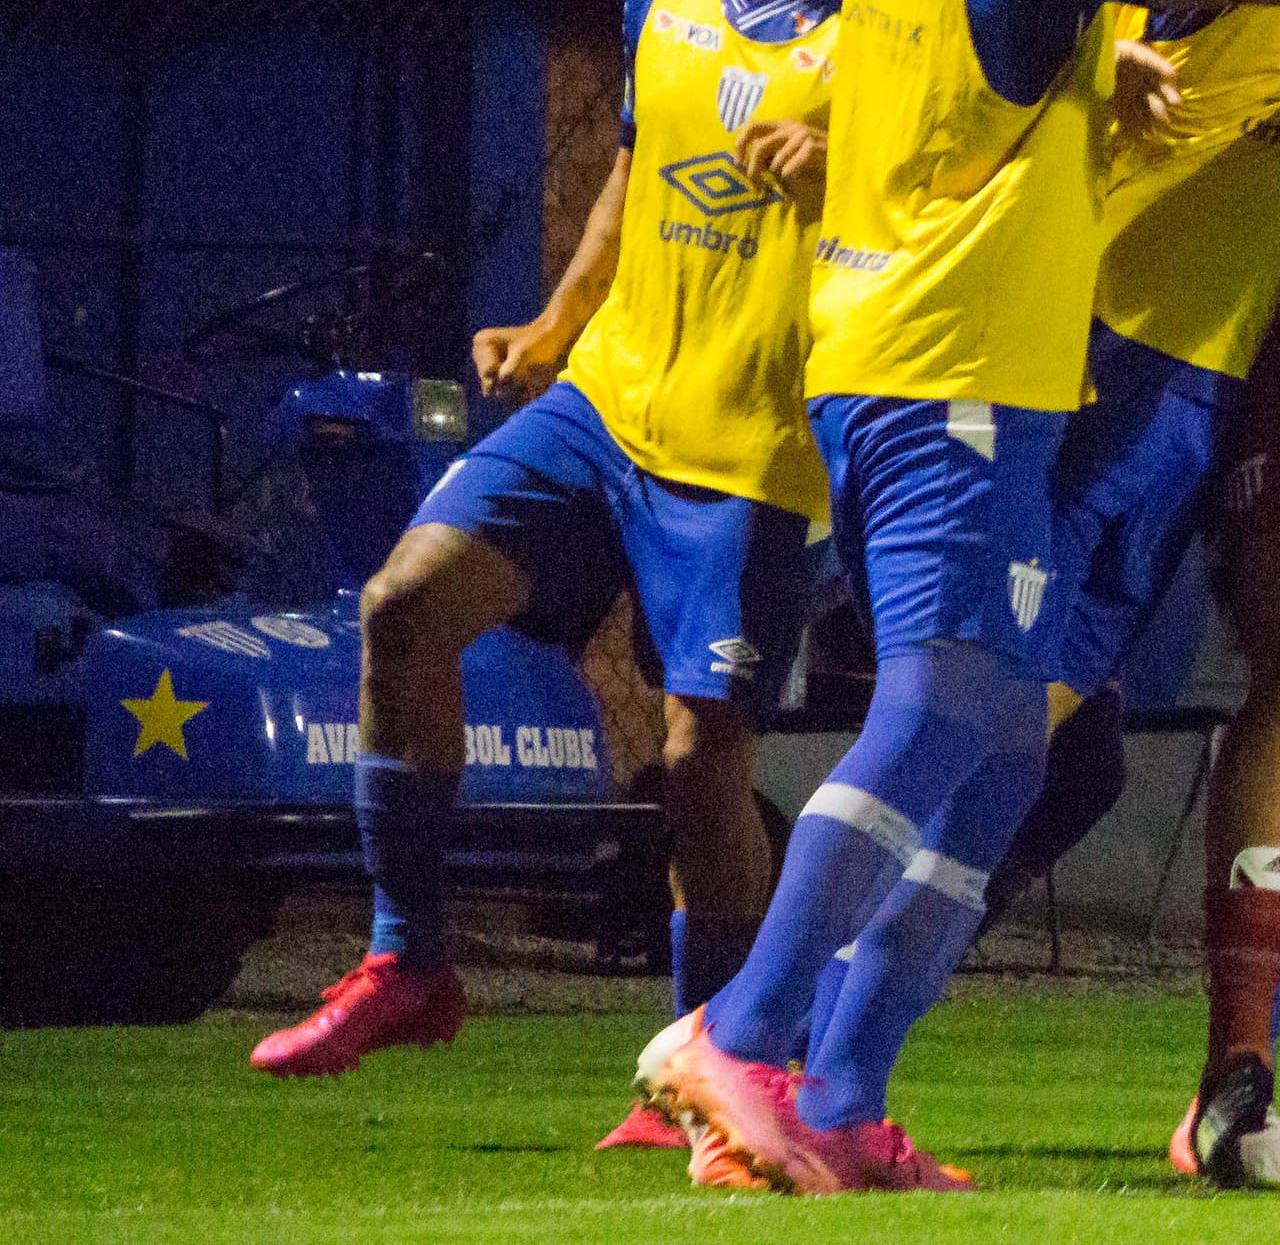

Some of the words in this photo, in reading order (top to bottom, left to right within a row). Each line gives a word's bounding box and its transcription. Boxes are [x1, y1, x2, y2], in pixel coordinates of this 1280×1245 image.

[660, 219, 760, 261] umbro
[307, 723, 361, 764] AVA
[516, 725, 598, 769] CLUBE
